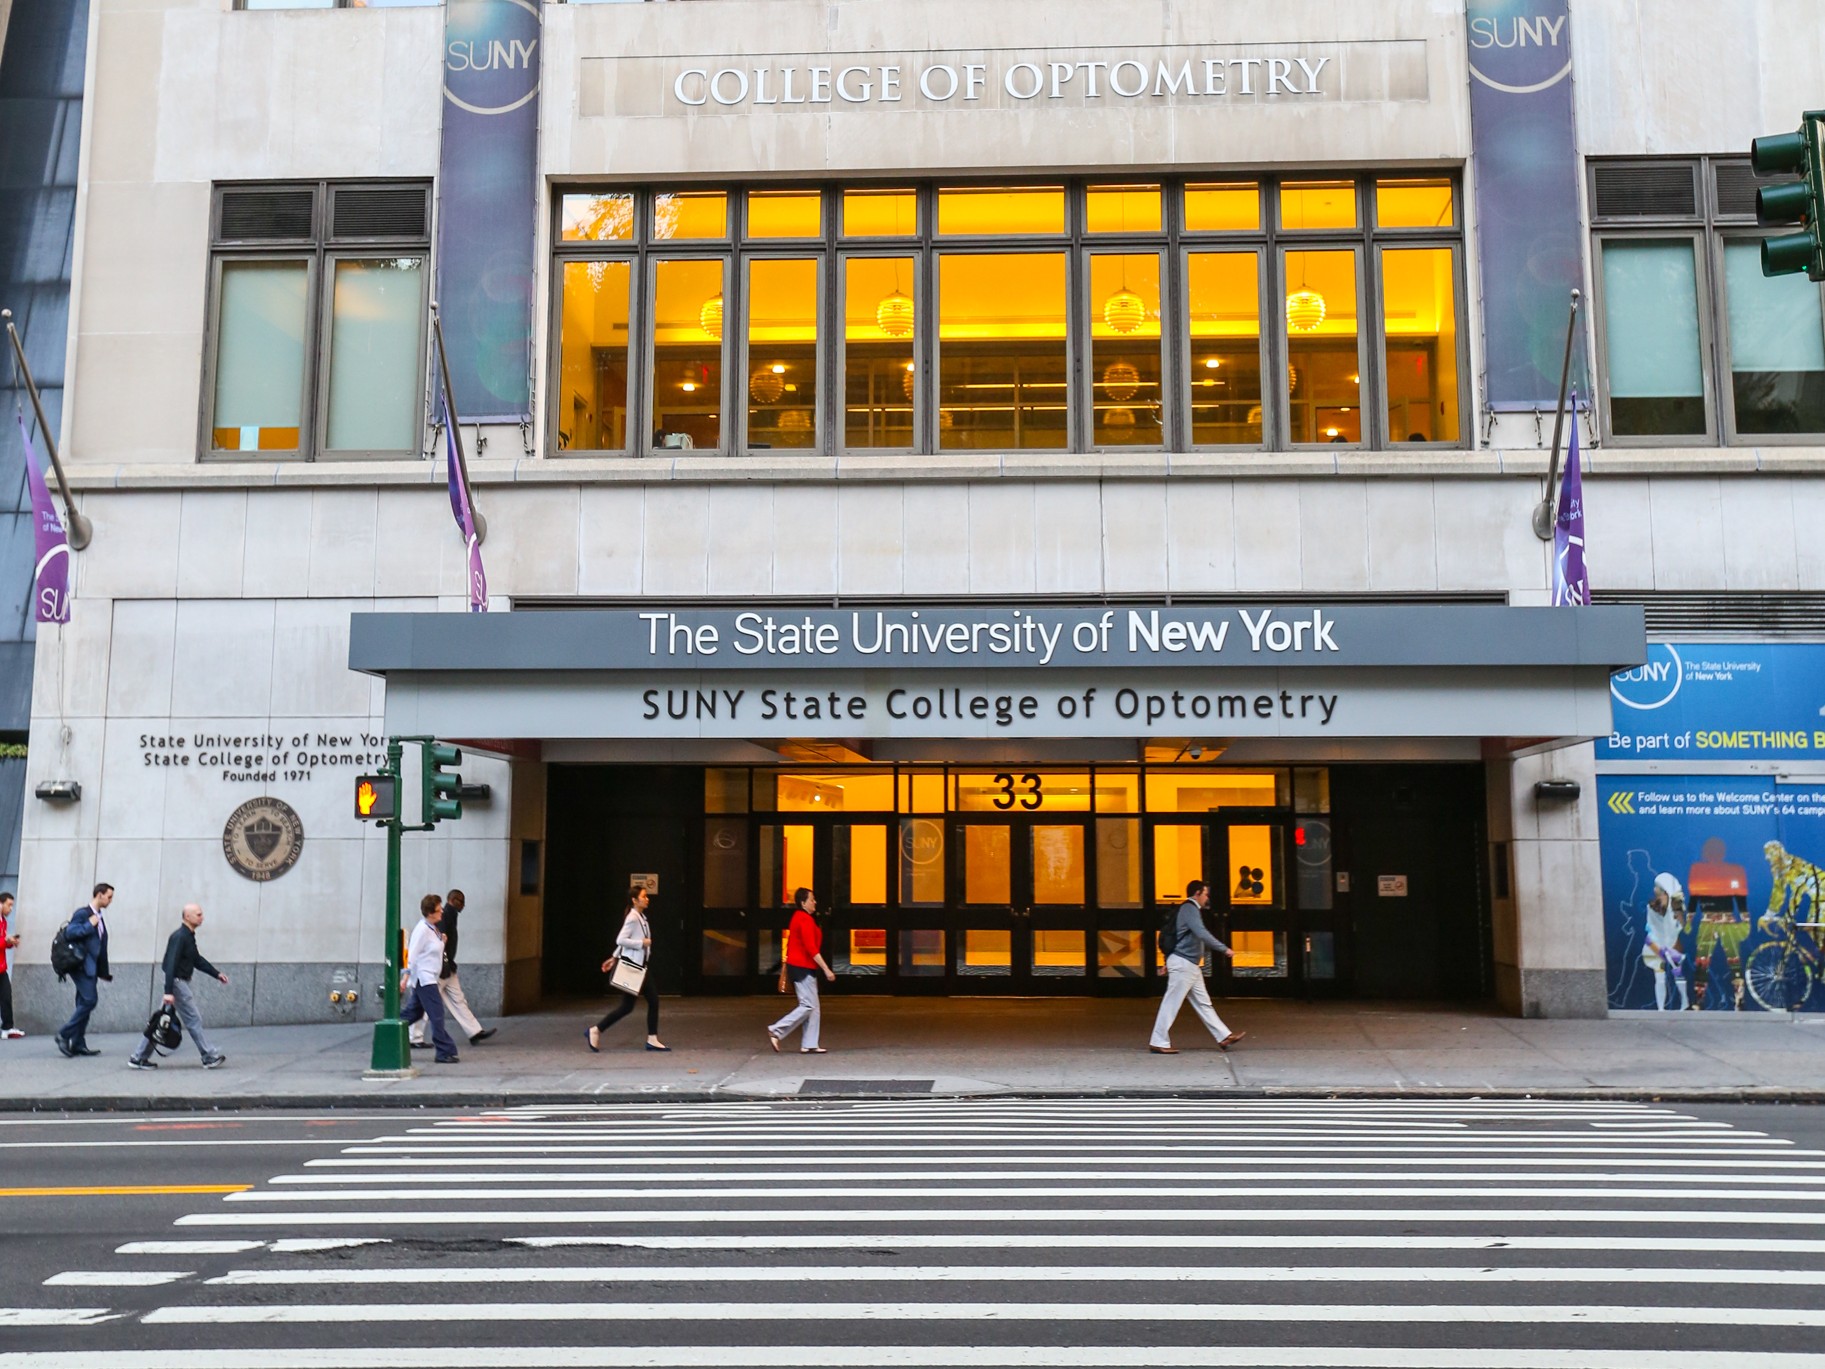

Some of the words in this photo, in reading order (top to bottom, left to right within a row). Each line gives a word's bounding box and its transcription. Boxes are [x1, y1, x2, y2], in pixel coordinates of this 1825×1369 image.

[1471, 15, 1566, 48] SUNY
[447, 39, 537, 71] SUNY
[673, 65, 902, 106] COLLEGE
[919, 64, 987, 102] OF
[1004, 57, 1331, 100] OPTOMETRY
[639, 613, 719, 655] The
[733, 612, 840, 655] State
[852, 611, 1063, 665] University
[1072, 611, 1114, 652] of
[1128, 610, 1229, 653] New
[1238, 609, 1340, 652] York
[1685, 661, 1701, 670] The
[1702, 661, 1721, 670] State
[1723, 661, 1761, 672] University
[1686, 672, 1694, 680] of
[1695, 672, 1714, 680] New
[1715, 671, 1733, 680] York
[643, 690, 745, 719] SUNY
[761, 690, 867, 719] State
[886, 688, 1039, 725] College
[1057, 688, 1097, 719] of
[1115, 688, 1339, 726] Optometry
[140, 734, 185, 748] State
[194, 733, 283, 750] University
[292, 732, 309, 747] of
[318, 733, 352, 747] New
[360, 732, 389, 747] Yor
[1609, 731, 1631, 748] Be
[1636, 732, 1669, 752] part
[1674, 731, 1691, 748] of
[1696, 731, 1808, 749] SOMETHING
[144, 752, 190, 766] State
[198, 752, 263, 769] College
[272, 751, 290, 766] of
[297, 751, 388, 769] Optometry
[223, 771, 276, 782] Founded
[284, 771, 311, 781] 1971
[993, 773, 1043, 810] 33
[1638, 792, 1670, 802] Follow
[1672, 794, 1684, 802] us
[1686, 792, 1697, 802] to
[1698, 792, 1714, 802] the
[1716, 792, 1760, 802] Welcome
[1761, 792, 1794, 802] Center
[1797, 794, 1810, 802] on
[1639, 805, 1656, 814] and
[1658, 805, 1684, 814] learn
[1686, 806, 1711, 814] more
[1713, 804, 1740, 814] about
[1782, 804, 1795, 815] 64
[1797, 806, 1825, 817] camp
